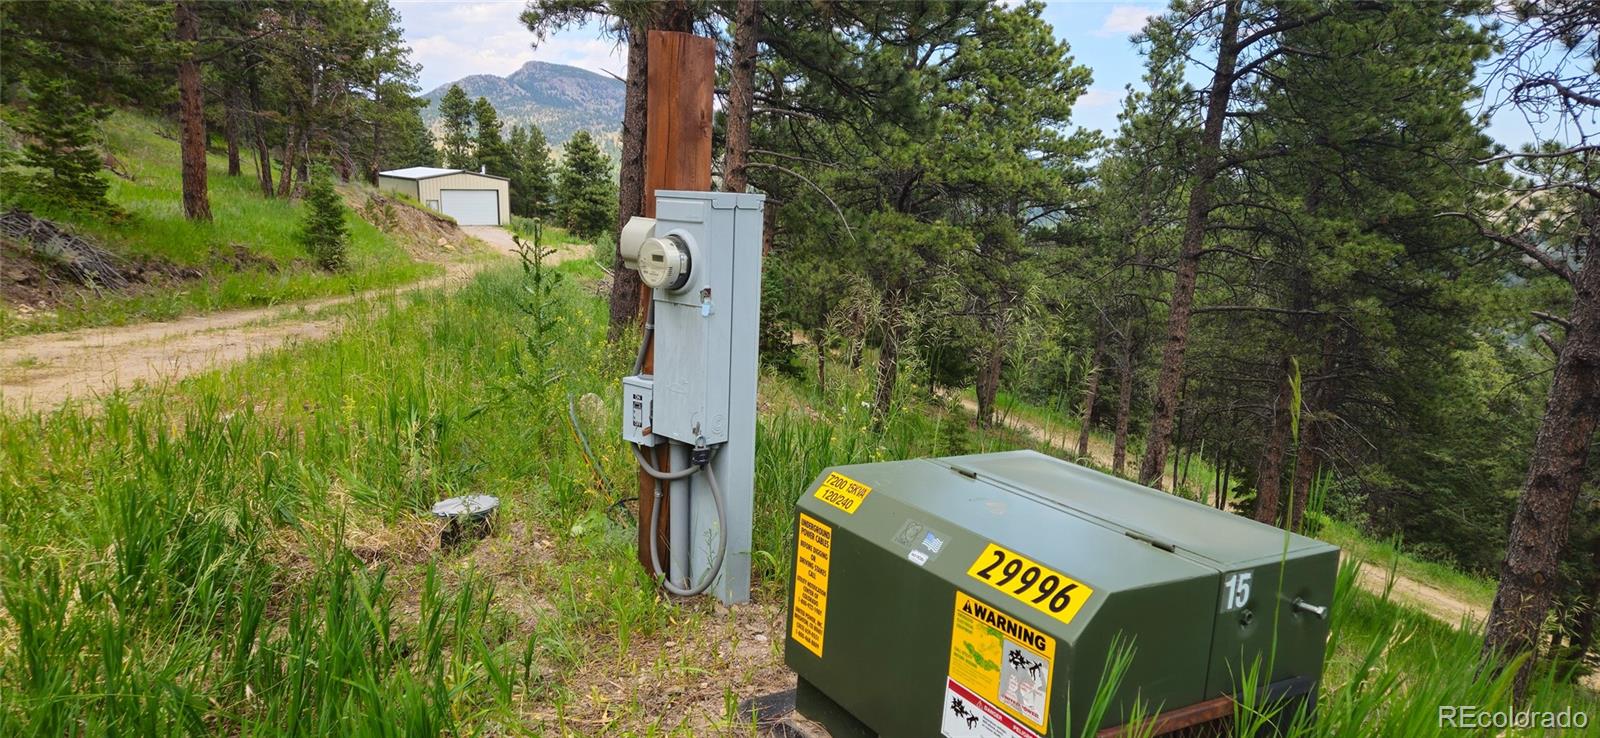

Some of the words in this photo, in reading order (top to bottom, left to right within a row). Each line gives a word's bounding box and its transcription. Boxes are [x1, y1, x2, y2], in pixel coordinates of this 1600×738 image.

[826, 474, 848, 490] 7200
[846, 482, 868, 499] 15KVA
[822, 488, 854, 510] 120/240
[801, 518, 830, 539] UNDERGROUND
[801, 527, 814, 540] POWER
[815, 535, 829, 548] CABLES
[801, 540, 812, 552] BEFORE
[813, 547, 828, 560] DIGGING
[811, 554, 816, 562] OR
[800, 556, 814, 570] DRIVING
[814, 565, 826, 577] STAKES
[808, 569, 816, 580] CALL
[976, 550, 1079, 613] 29996
[1224, 572, 1252, 609] 15
[974, 603, 1046, 651] WARNING
[983, 705, 1003, 720] DANGER
